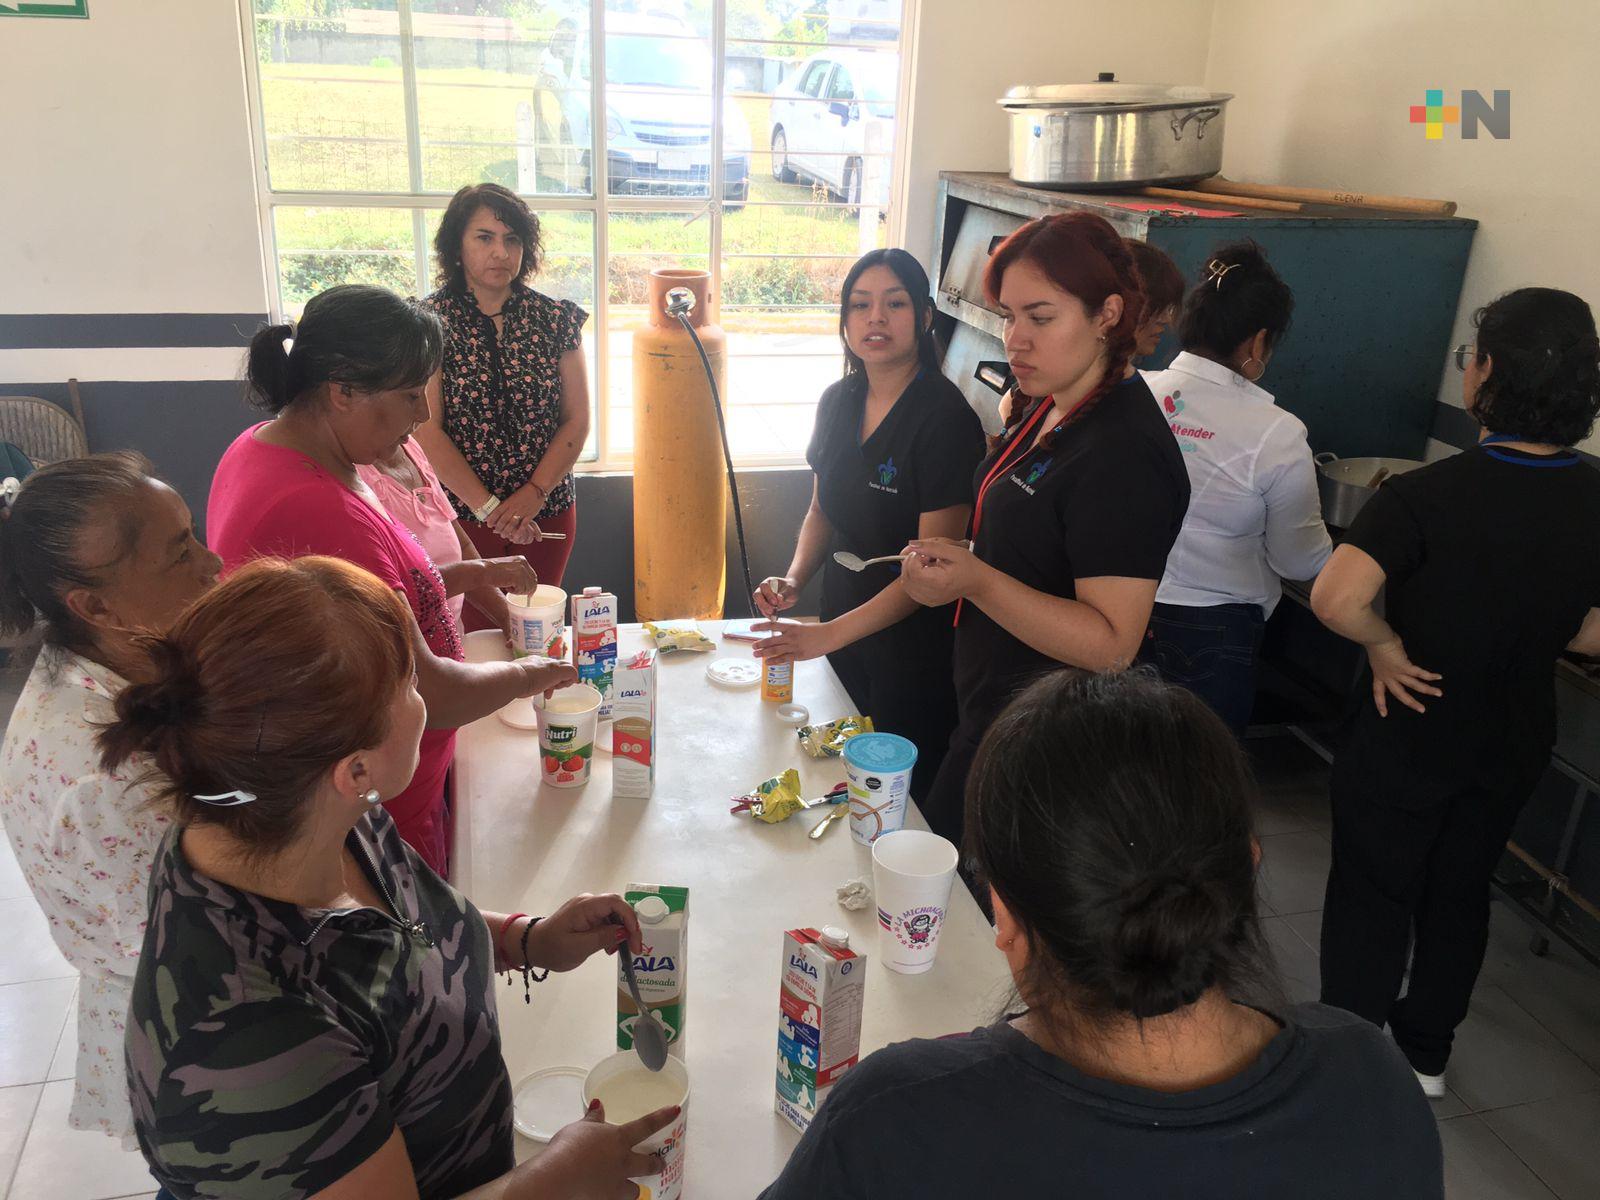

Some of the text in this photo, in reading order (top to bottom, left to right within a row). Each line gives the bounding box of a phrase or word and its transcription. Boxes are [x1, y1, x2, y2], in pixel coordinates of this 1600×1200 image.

[584, 606, 610, 618] LALA
[545, 727, 578, 740] Nutri
[622, 957, 675, 972] ALA
[790, 954, 818, 979] LALA
